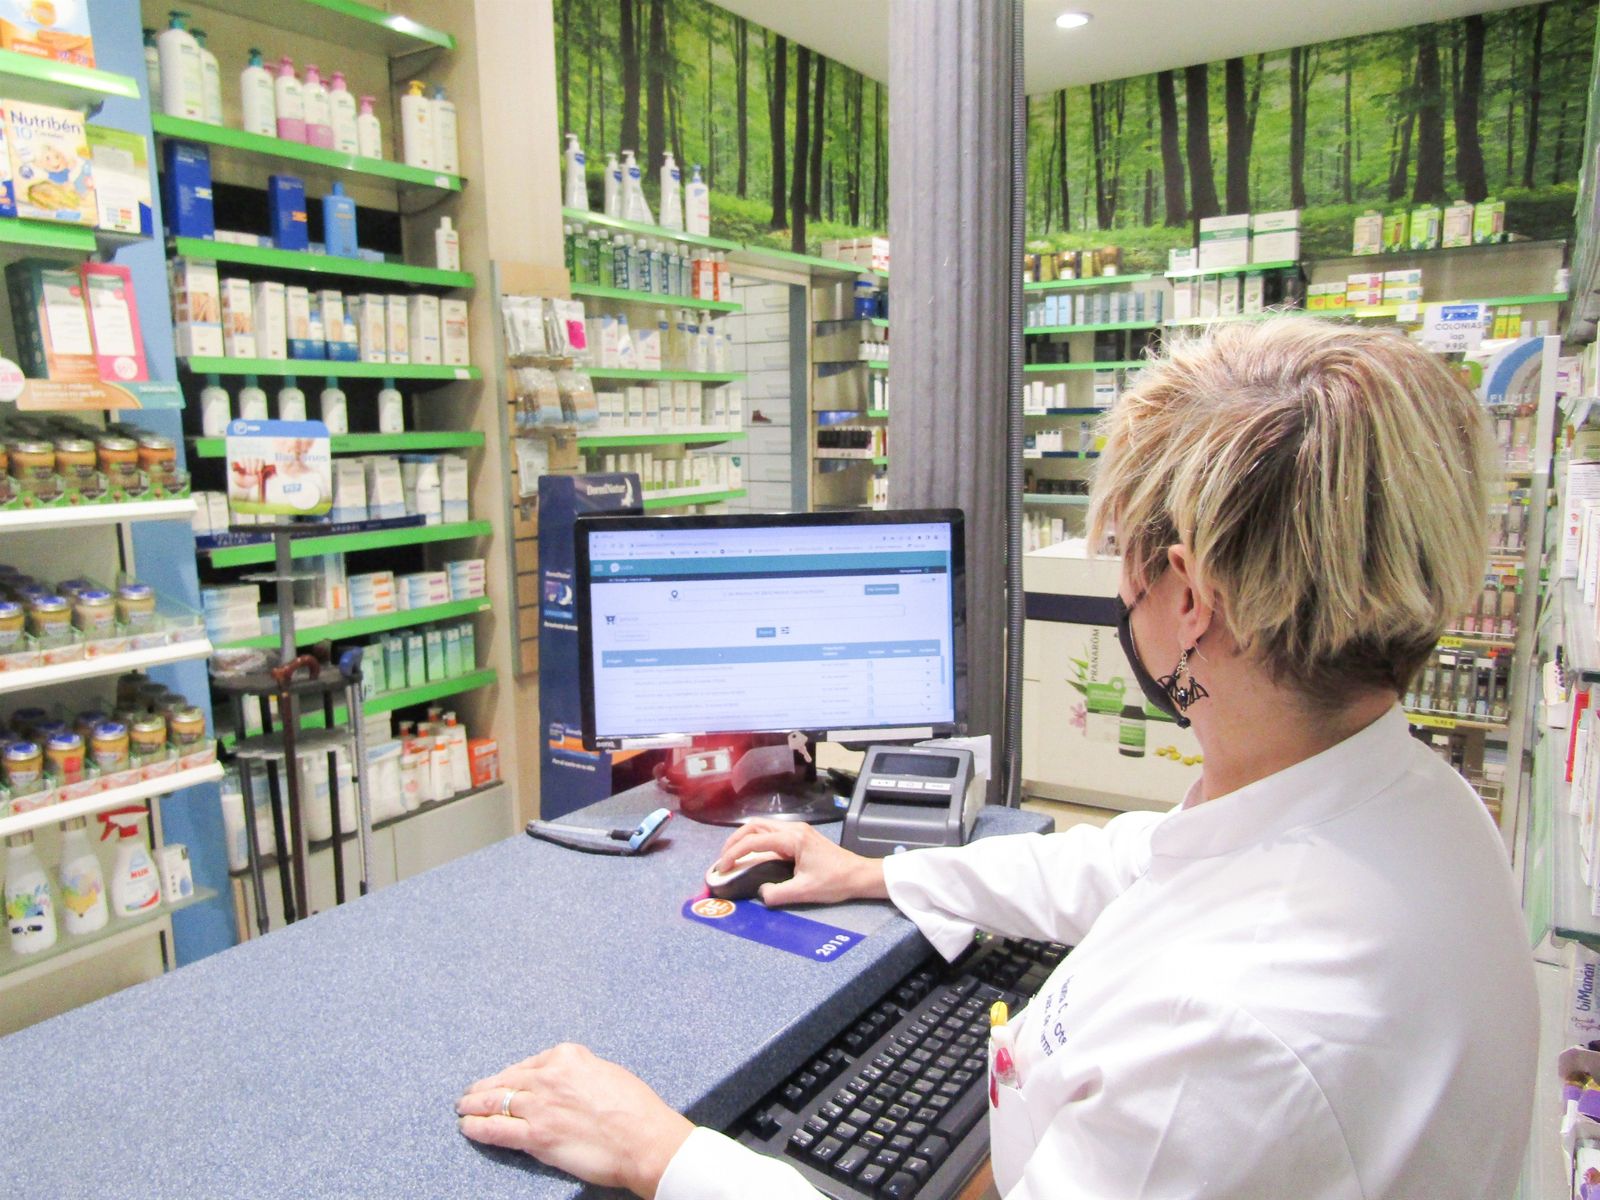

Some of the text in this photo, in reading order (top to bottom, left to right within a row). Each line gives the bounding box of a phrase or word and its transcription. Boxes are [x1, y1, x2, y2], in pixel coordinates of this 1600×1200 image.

[10, 110, 81, 135] Nutribén
[1435, 322, 1483, 331] COLONIAS
[815, 934, 852, 957] 2018
[1576, 963, 1596, 1012] biManán
